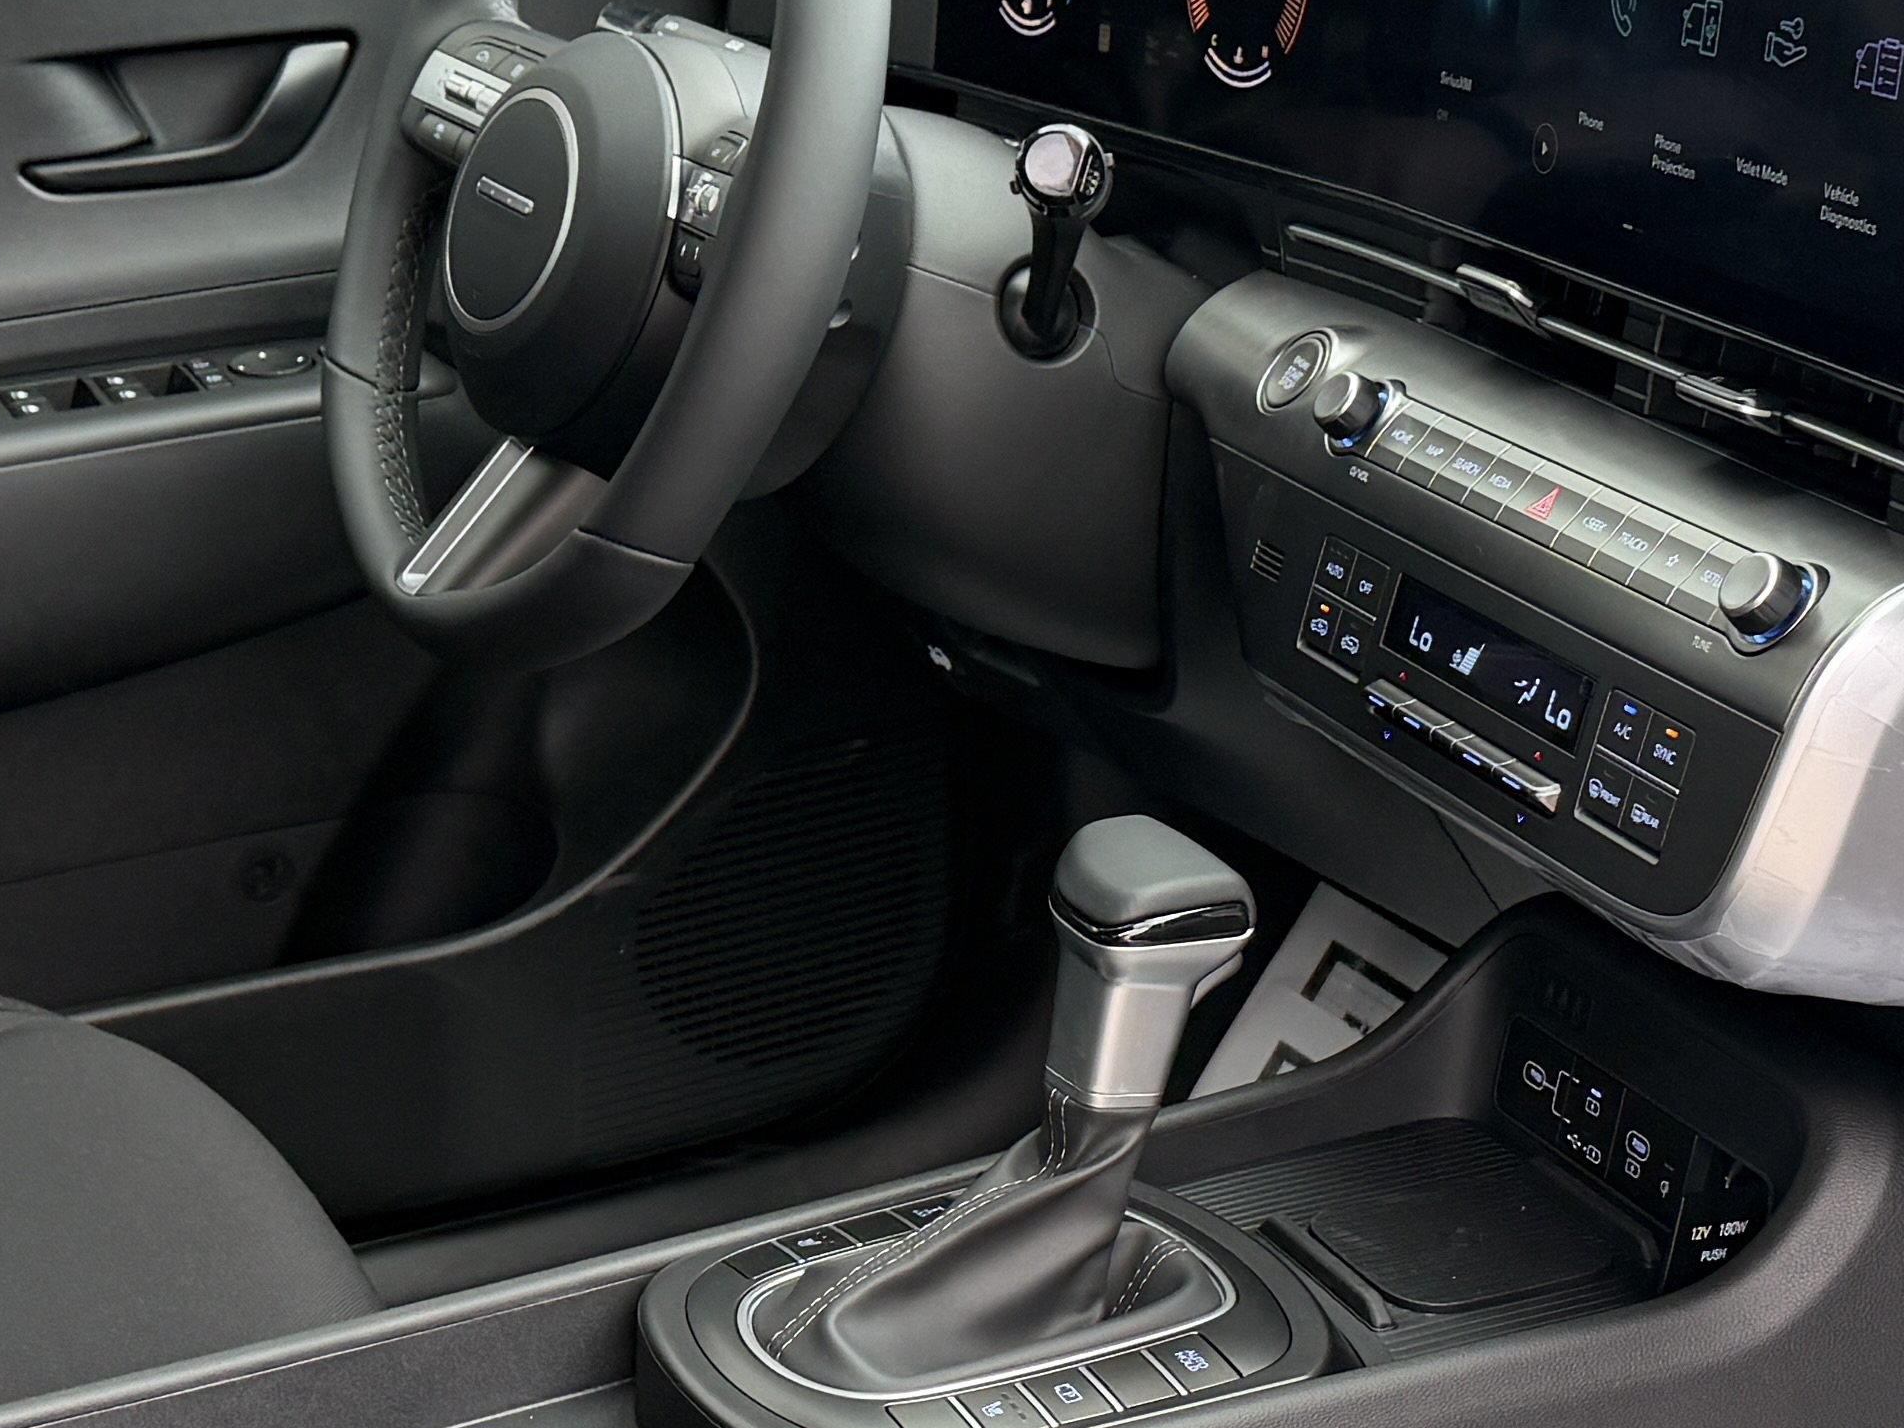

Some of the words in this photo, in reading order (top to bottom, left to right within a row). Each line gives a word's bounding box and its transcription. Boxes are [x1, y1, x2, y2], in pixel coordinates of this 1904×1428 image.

[1578, 109, 1605, 132] Phone
[1654, 132, 1683, 155] Phone
[1651, 154, 1696, 181] Projection
[1735, 156, 1761, 179] Valet
[1761, 165, 1789, 188] Mode
[1823, 181, 1860, 208] Vehicle
[1819, 204, 1879, 237] Diagnostics
[1690, 1223, 1714, 1242] 12V
[1699, 1246, 1728, 1264] PUSH
